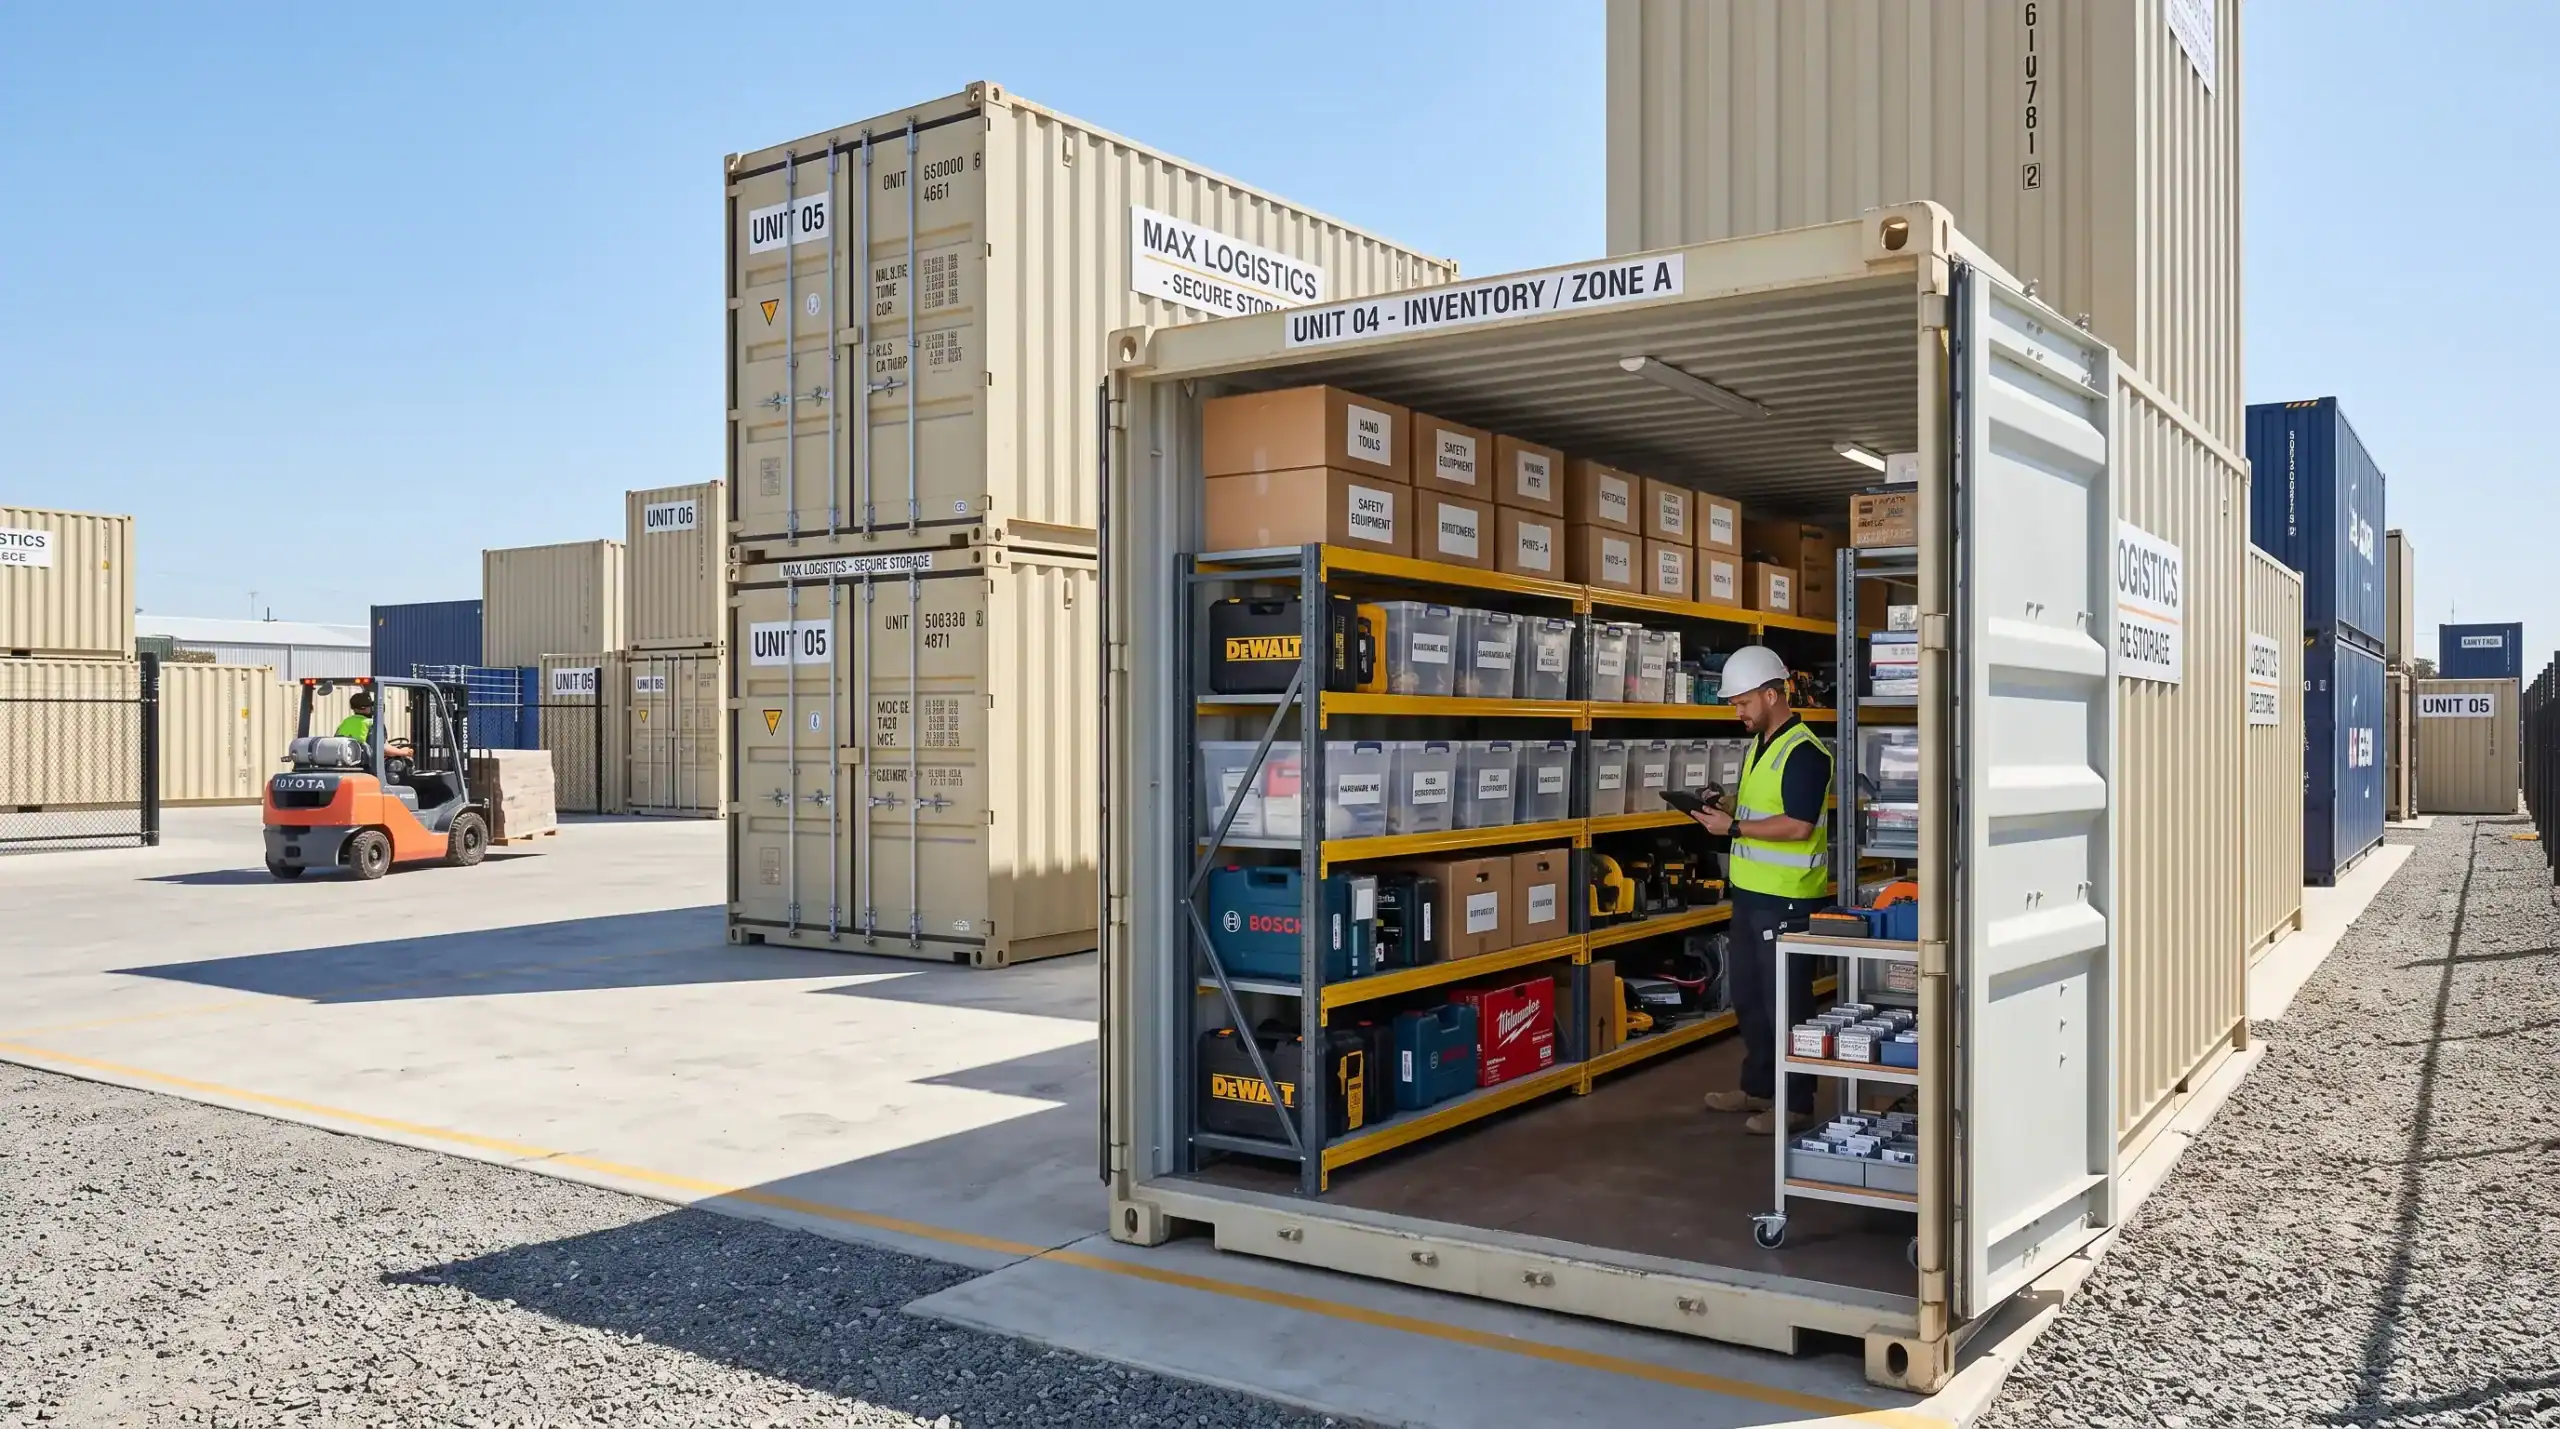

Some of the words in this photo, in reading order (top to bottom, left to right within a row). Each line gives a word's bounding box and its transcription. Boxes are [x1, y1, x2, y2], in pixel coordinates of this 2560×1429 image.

[924, 156, 964, 180] 650000
[753, 209, 796, 244] UNIT
[802, 203, 825, 232] 05
[1143, 219, 1196, 263] MAX
[1204, 239, 1317, 300] LOGISTICS
[1173, 274, 1233, 309] SECURE
[1294, 310, 1346, 342] UNIT
[1353, 306, 1380, 334] 04
[1404, 280, 1547, 327] INVENTORY
[1552, 276, 1565, 309] /
[1572, 264, 1645, 303] ZONE
[1653, 262, 1673, 291] A
[1358, 498, 1384, 513] SAFETY
[647, 507, 675, 527] UNIT
[678, 506, 693, 524] 06
[1351, 512, 1392, 531] EQUIPMENT
[0, 533, 46, 548] STICS
[783, 564, 802, 576] MAX
[804, 560, 847, 575] LOGISTICS
[855, 557, 888, 572] SECURE
[890, 554, 930, 569] STORAGE
[2117, 538, 2178, 608] OGISTICS
[885, 614, 910, 630] UNIT
[804, 629, 827, 656] 05
[924, 632, 950, 649] 4871
[2117, 621, 2132, 659] RE
[2132, 624, 2170, 666] STORAGE
[555, 673, 580, 690] UNIT
[2423, 698, 2463, 714] UNIT
[2468, 698, 2490, 713] 05
[275, 778, 326, 790] TOYOTA
